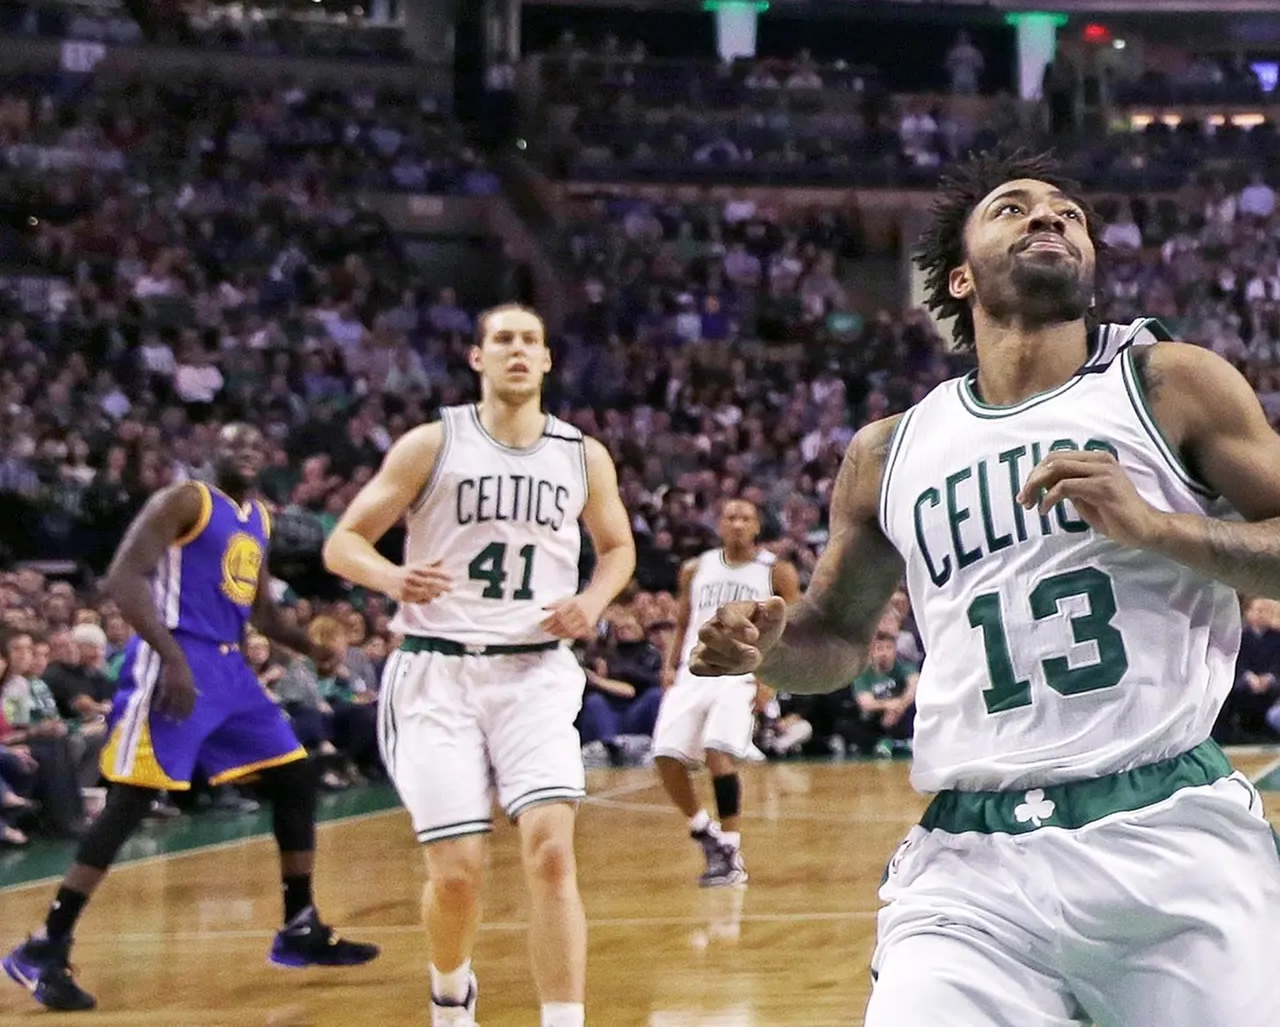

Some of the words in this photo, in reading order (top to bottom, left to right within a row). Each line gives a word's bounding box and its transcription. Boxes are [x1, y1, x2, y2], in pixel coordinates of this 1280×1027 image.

[456, 474, 569, 532] CELTICS
[913, 438, 1119, 588] CELTIC
[467, 541, 537, 601] 41
[966, 565, 1129, 715] 13
